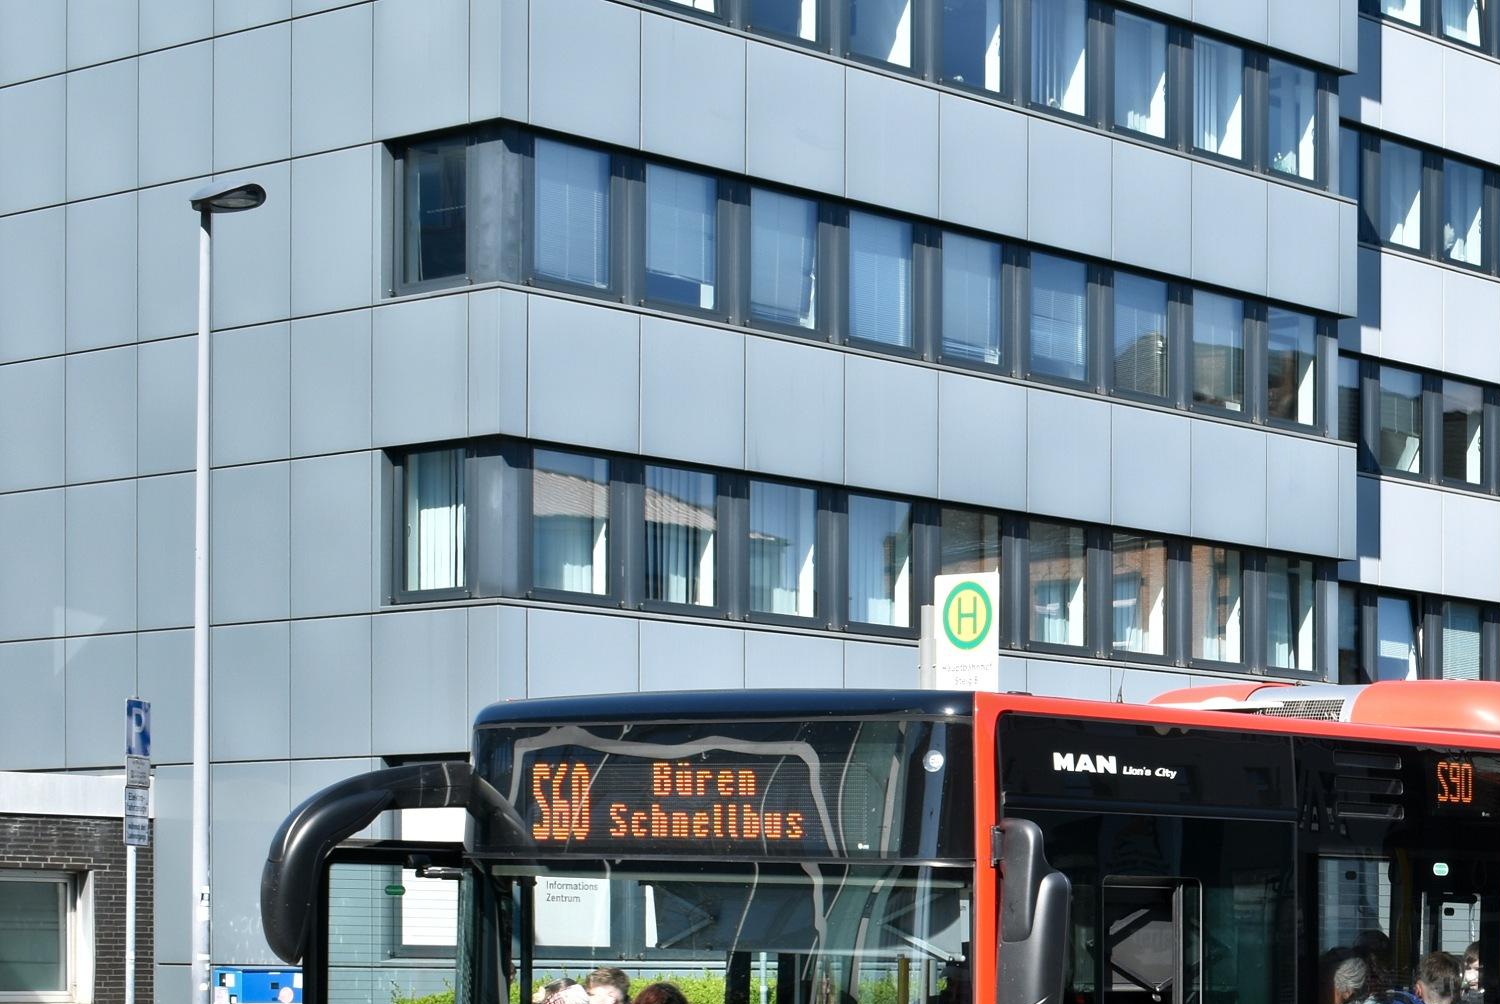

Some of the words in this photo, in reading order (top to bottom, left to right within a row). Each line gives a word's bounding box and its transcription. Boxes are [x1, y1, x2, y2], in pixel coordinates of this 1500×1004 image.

[957, 596, 977, 635] H
[132, 707, 145, 751] P
[653, 763, 756, 797] Büren
[1053, 752, 1117, 774] MAN
[1122, 766, 1152, 776] Lion's
[1154, 767, 1178, 780] City
[1437, 761, 1472, 803] S90
[533, 763, 590, 840] S60
[610, 804, 802, 839] Schnellbus
[546, 881, 599, 891] Informations
[546, 892, 581, 903] Zentrum
